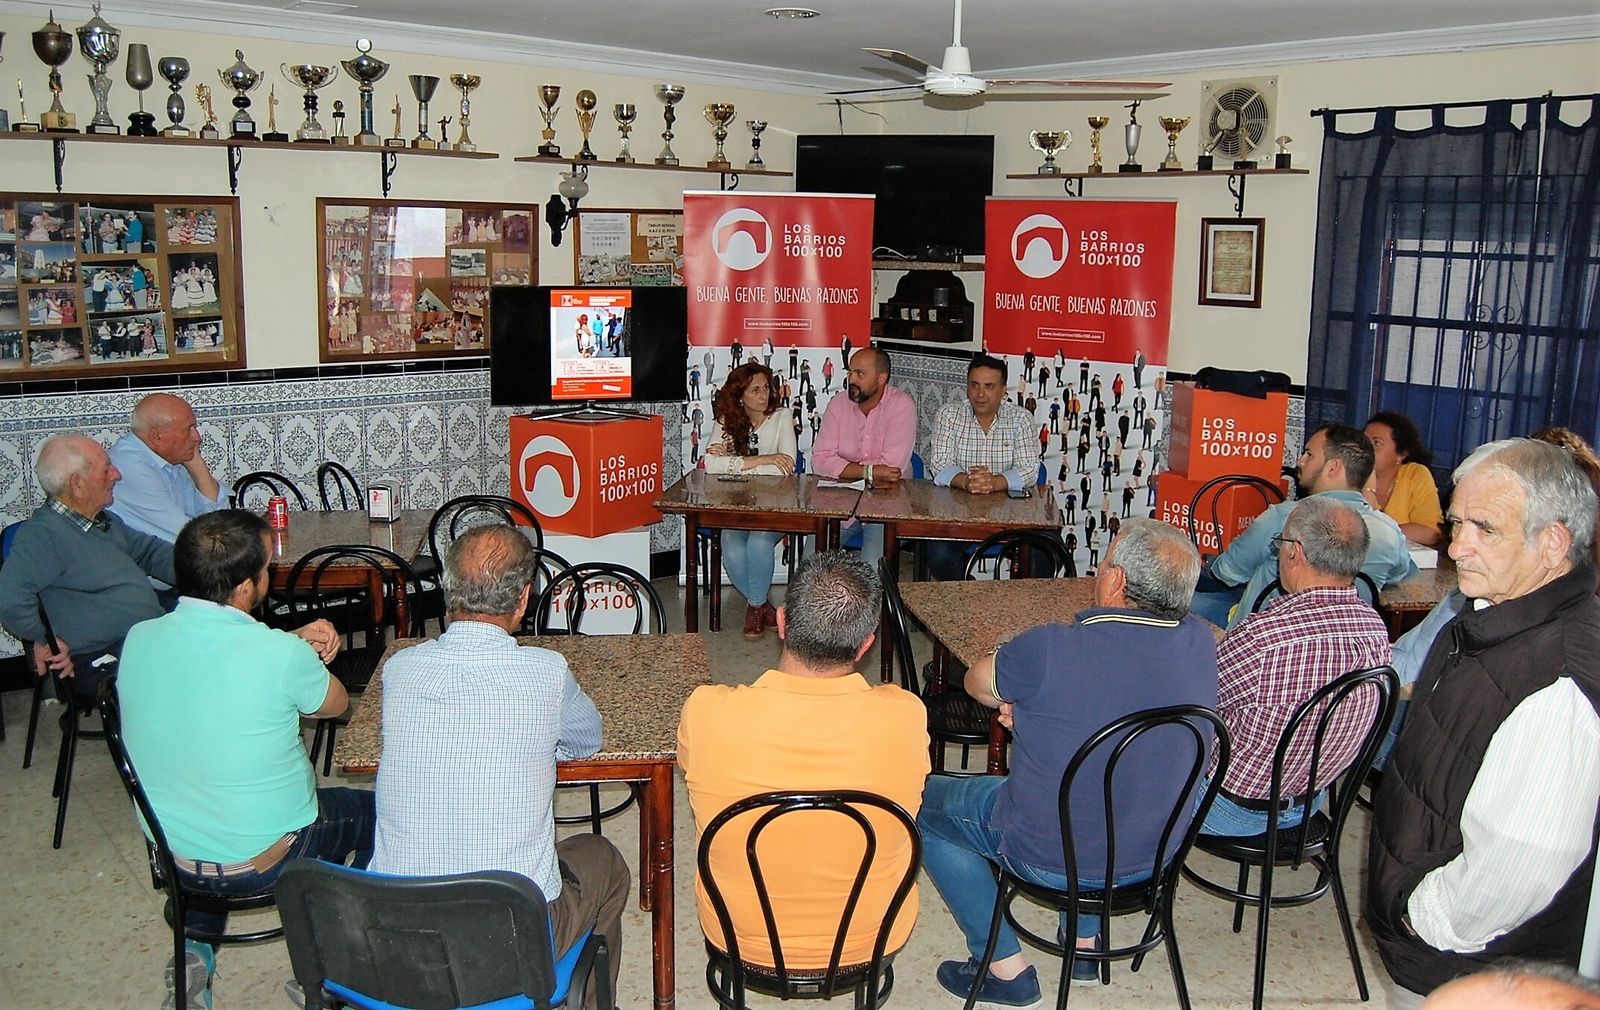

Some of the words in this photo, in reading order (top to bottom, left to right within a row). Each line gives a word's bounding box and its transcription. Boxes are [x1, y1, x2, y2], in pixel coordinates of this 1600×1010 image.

[784, 223, 811, 234] LOS
[1080, 230, 1108, 241] LOS
[784, 234, 846, 245] BARRIOS
[784, 246, 843, 258] 100x100
[1080, 241, 1145, 254] BARRIOS
[1080, 253, 1141, 267] 100x100
[696, 286, 730, 303] BUENA
[735, 286, 769, 305] GENTE,
[774, 286, 812, 303] BUENAS
[816, 287, 859, 305] RAZONES
[995, 292, 1025, 311] BUENA
[1029, 295, 1063, 314] GENTE,
[1067, 295, 1106, 316] BUENAS
[1109, 299, 1157, 318] RAZONES
[1202, 417, 1235, 429] LOS
[1201, 430, 1278, 444] BARRIOS
[1200, 442, 1273, 459] 100x100
[599, 454, 626, 471] LOS
[599, 462, 658, 486] BARRIOS
[599, 478, 655, 504] 100x100
[1163, 500, 1190, 516] LOS
